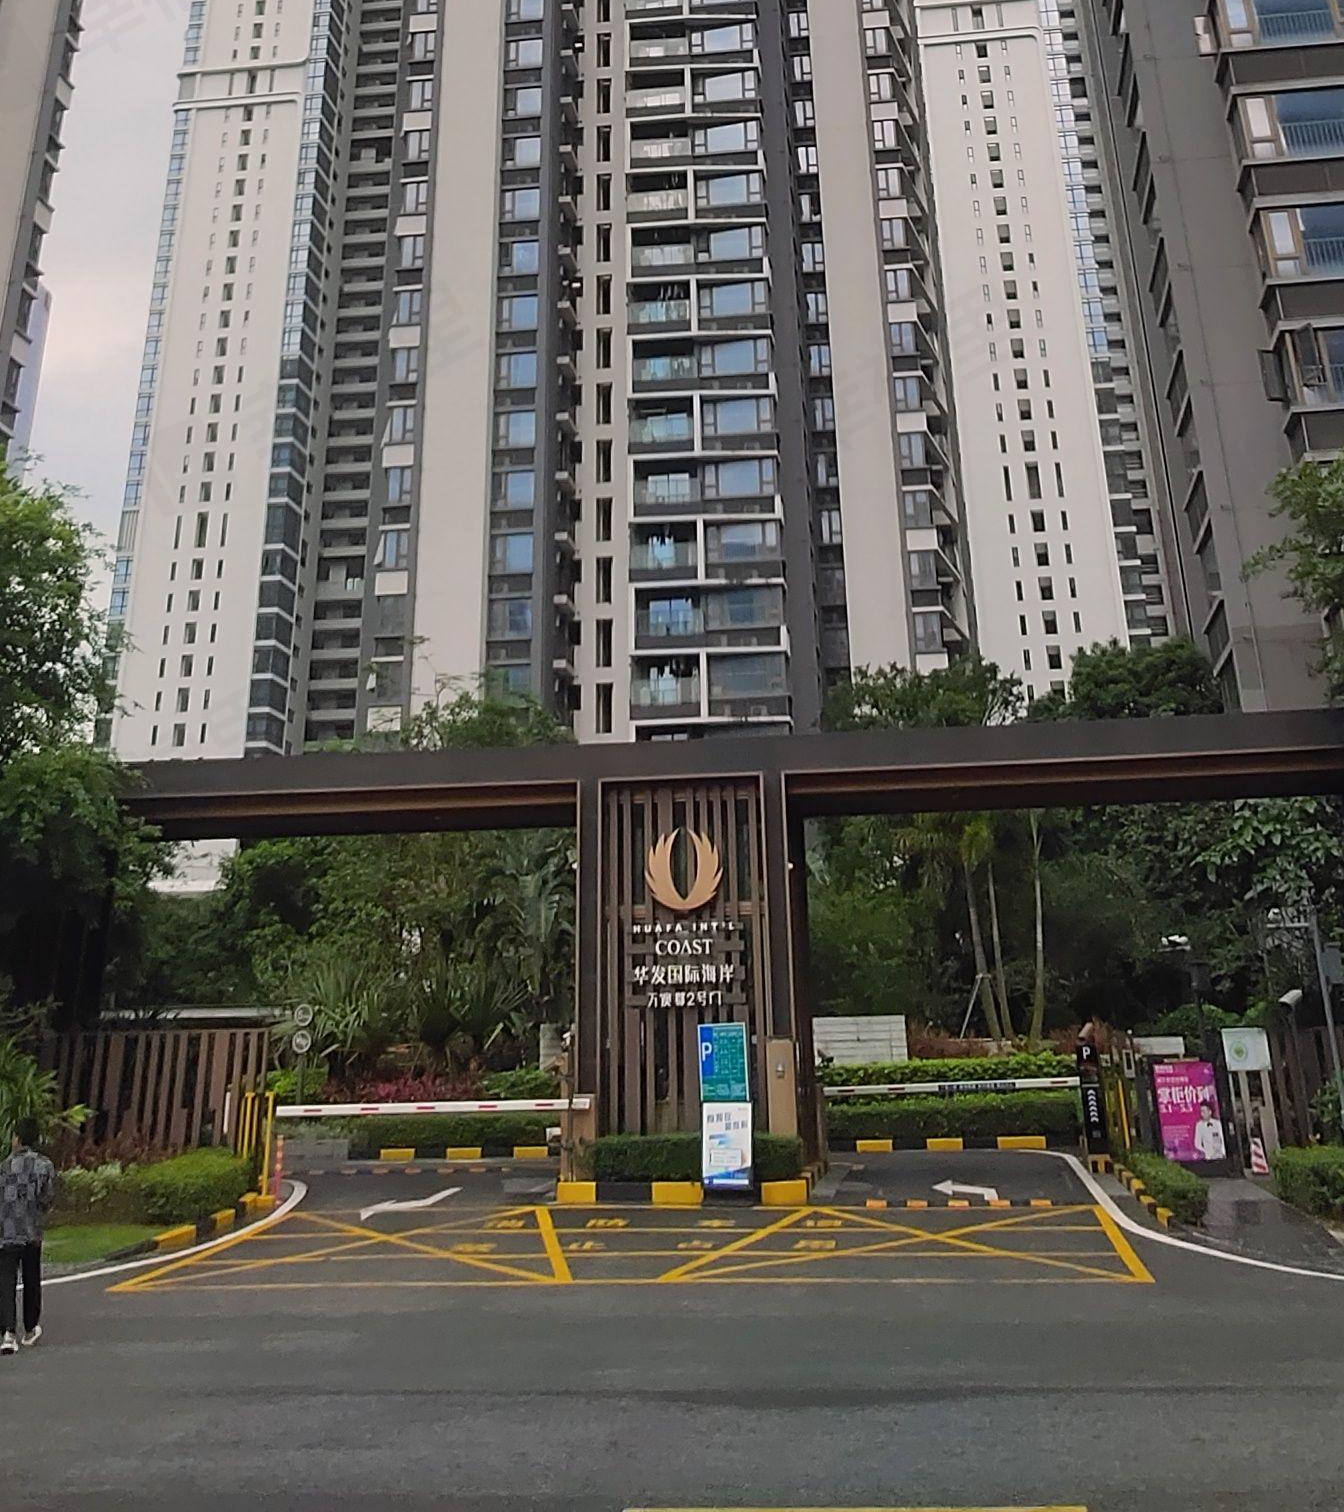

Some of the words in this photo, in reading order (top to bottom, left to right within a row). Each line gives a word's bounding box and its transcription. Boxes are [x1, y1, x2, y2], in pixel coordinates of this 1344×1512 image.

[633, 922, 682, 934] HUAFA
[655, 938, 713, 955] COAST
[634, 963, 735, 985] 华发国际海岸
[701, 1041, 713, 1062] P
[1082, 1045, 1091, 1060] P
